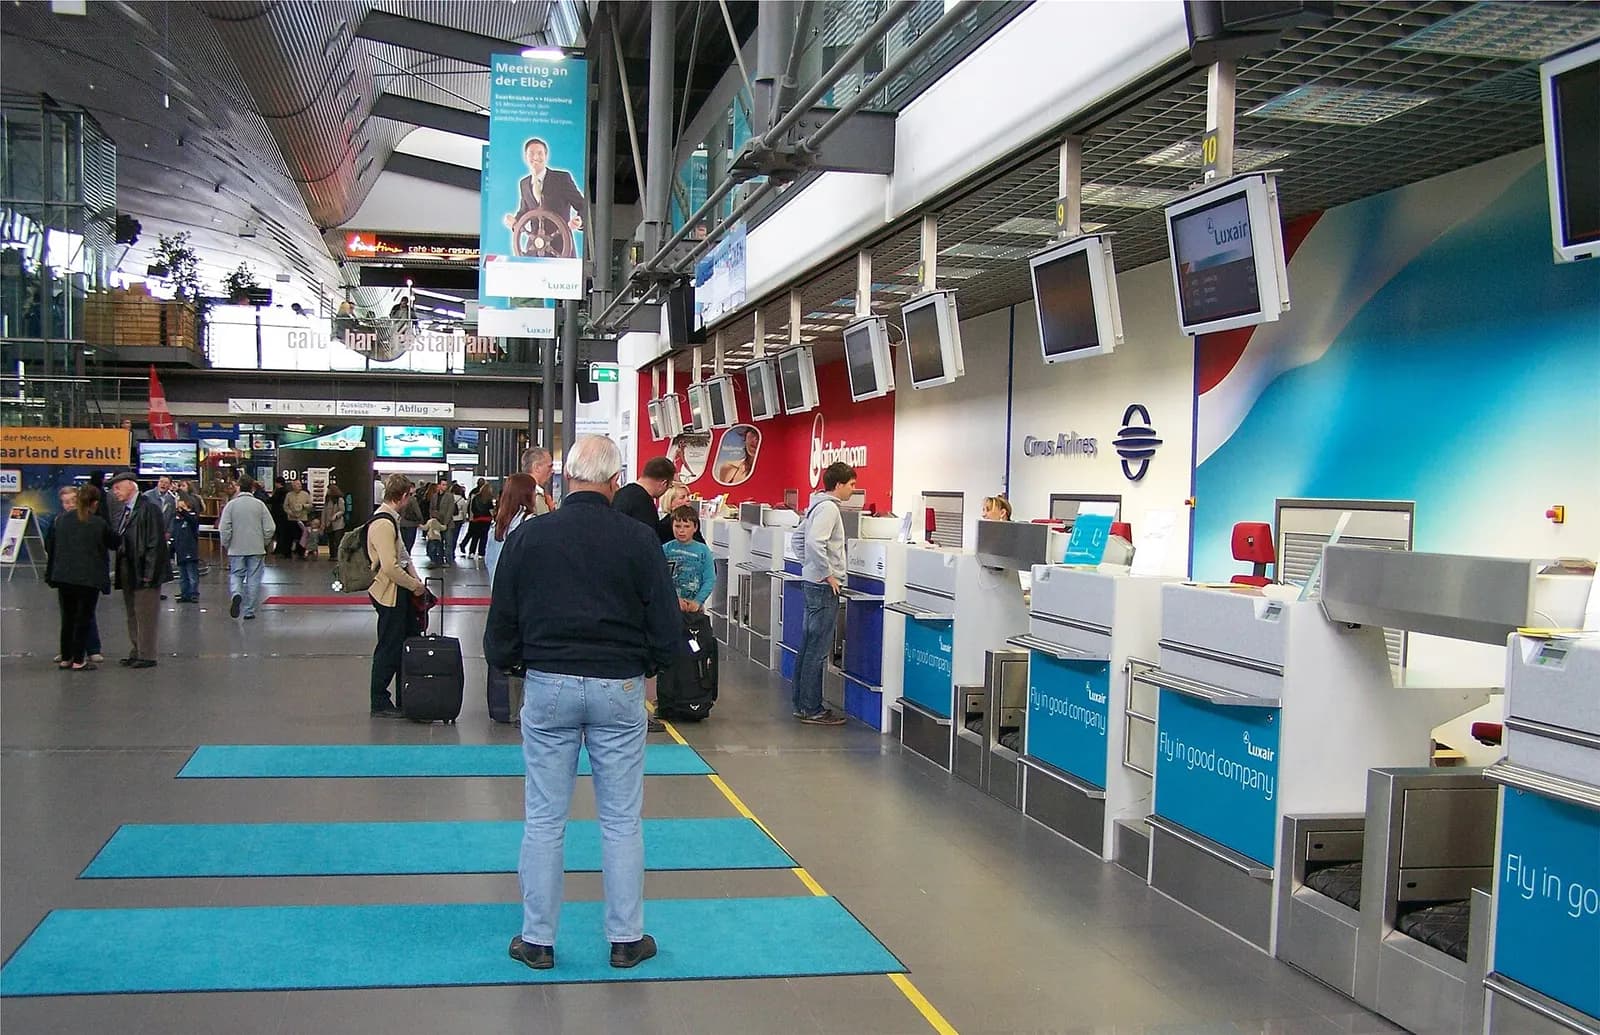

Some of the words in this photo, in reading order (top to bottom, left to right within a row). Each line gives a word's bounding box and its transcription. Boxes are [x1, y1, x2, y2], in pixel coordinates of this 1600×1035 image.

[496, 63, 549, 77] Meeting
[552, 67, 568, 76] an
[495, 77, 516, 86] der
[520, 78, 553, 88] Elbe?
[1203, 136, 1216, 166] 10
[1058, 203, 1064, 226] 9
[1214, 221, 1248, 245] Luxair
[345, 328, 377, 351] bar
[398, 404, 429, 415] Abflug
[64, 447, 121, 460] strahlt!
[1024, 436, 1055, 457] Cirrus
[1055, 431, 1098, 457] Airlines
[282, 470, 297, 480] 80
[1031, 686, 1041, 711] Fly
[1041, 691, 1048, 708] in
[1049, 697, 1068, 716] good
[1068, 703, 1106, 736] company
[1247, 742, 1275, 762] Luxair
[1159, 732, 1174, 762] Fly
[1176, 738, 1185, 760] in
[1187, 746, 1215, 771] good
[1217, 757, 1274, 800] company
[1506, 853, 1536, 899] Fly
[1542, 866, 1561, 901] in
[1567, 883, 1600, 918] go
